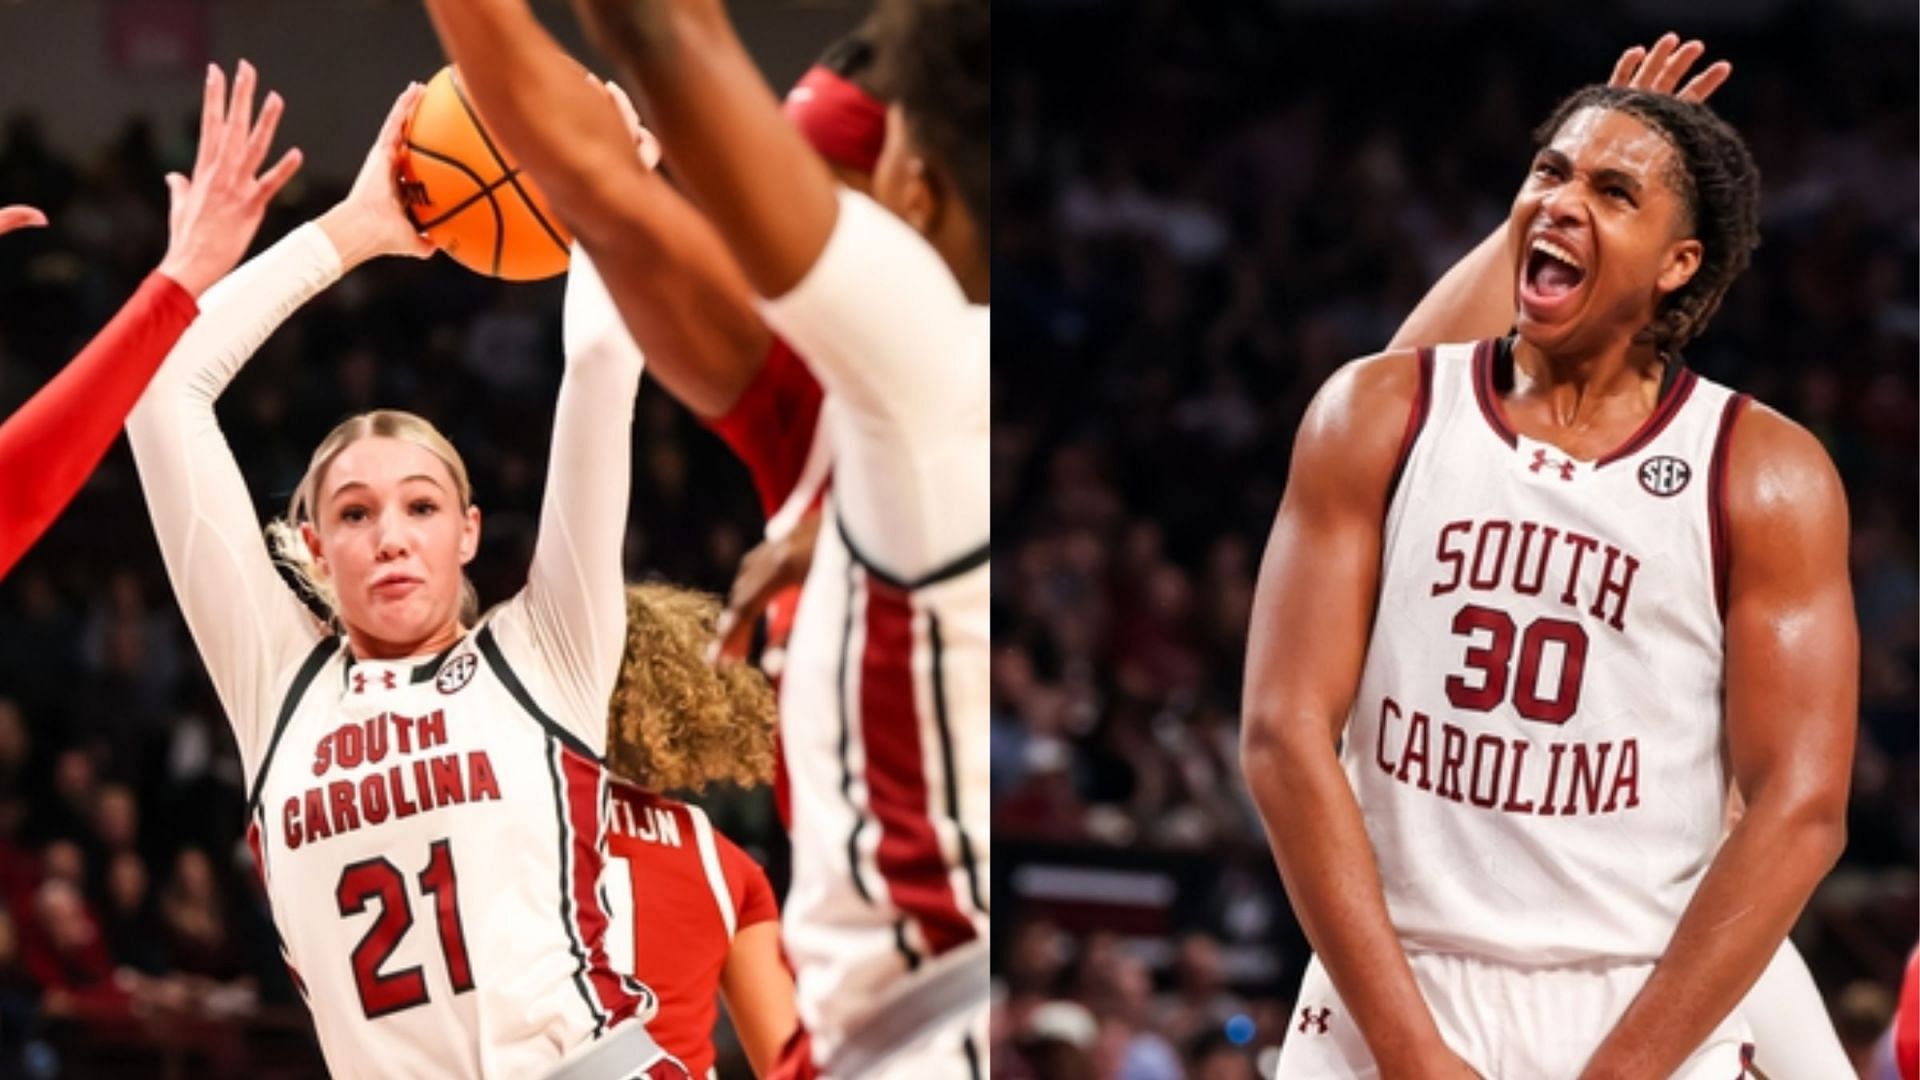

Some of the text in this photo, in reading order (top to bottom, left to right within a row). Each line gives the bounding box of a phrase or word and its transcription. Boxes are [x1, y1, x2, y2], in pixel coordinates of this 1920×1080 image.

[1641, 459, 1689, 494] SEC
[1431, 520, 1640, 631] SOUTH
[438, 655, 476, 692] SEC
[1445, 604, 1589, 725] 30
[313, 709, 448, 777] SOUTH
[1376, 697, 1640, 815] CAROLINA
[282, 750, 502, 849] CAROLINA
[335, 837, 476, 1020] 21
